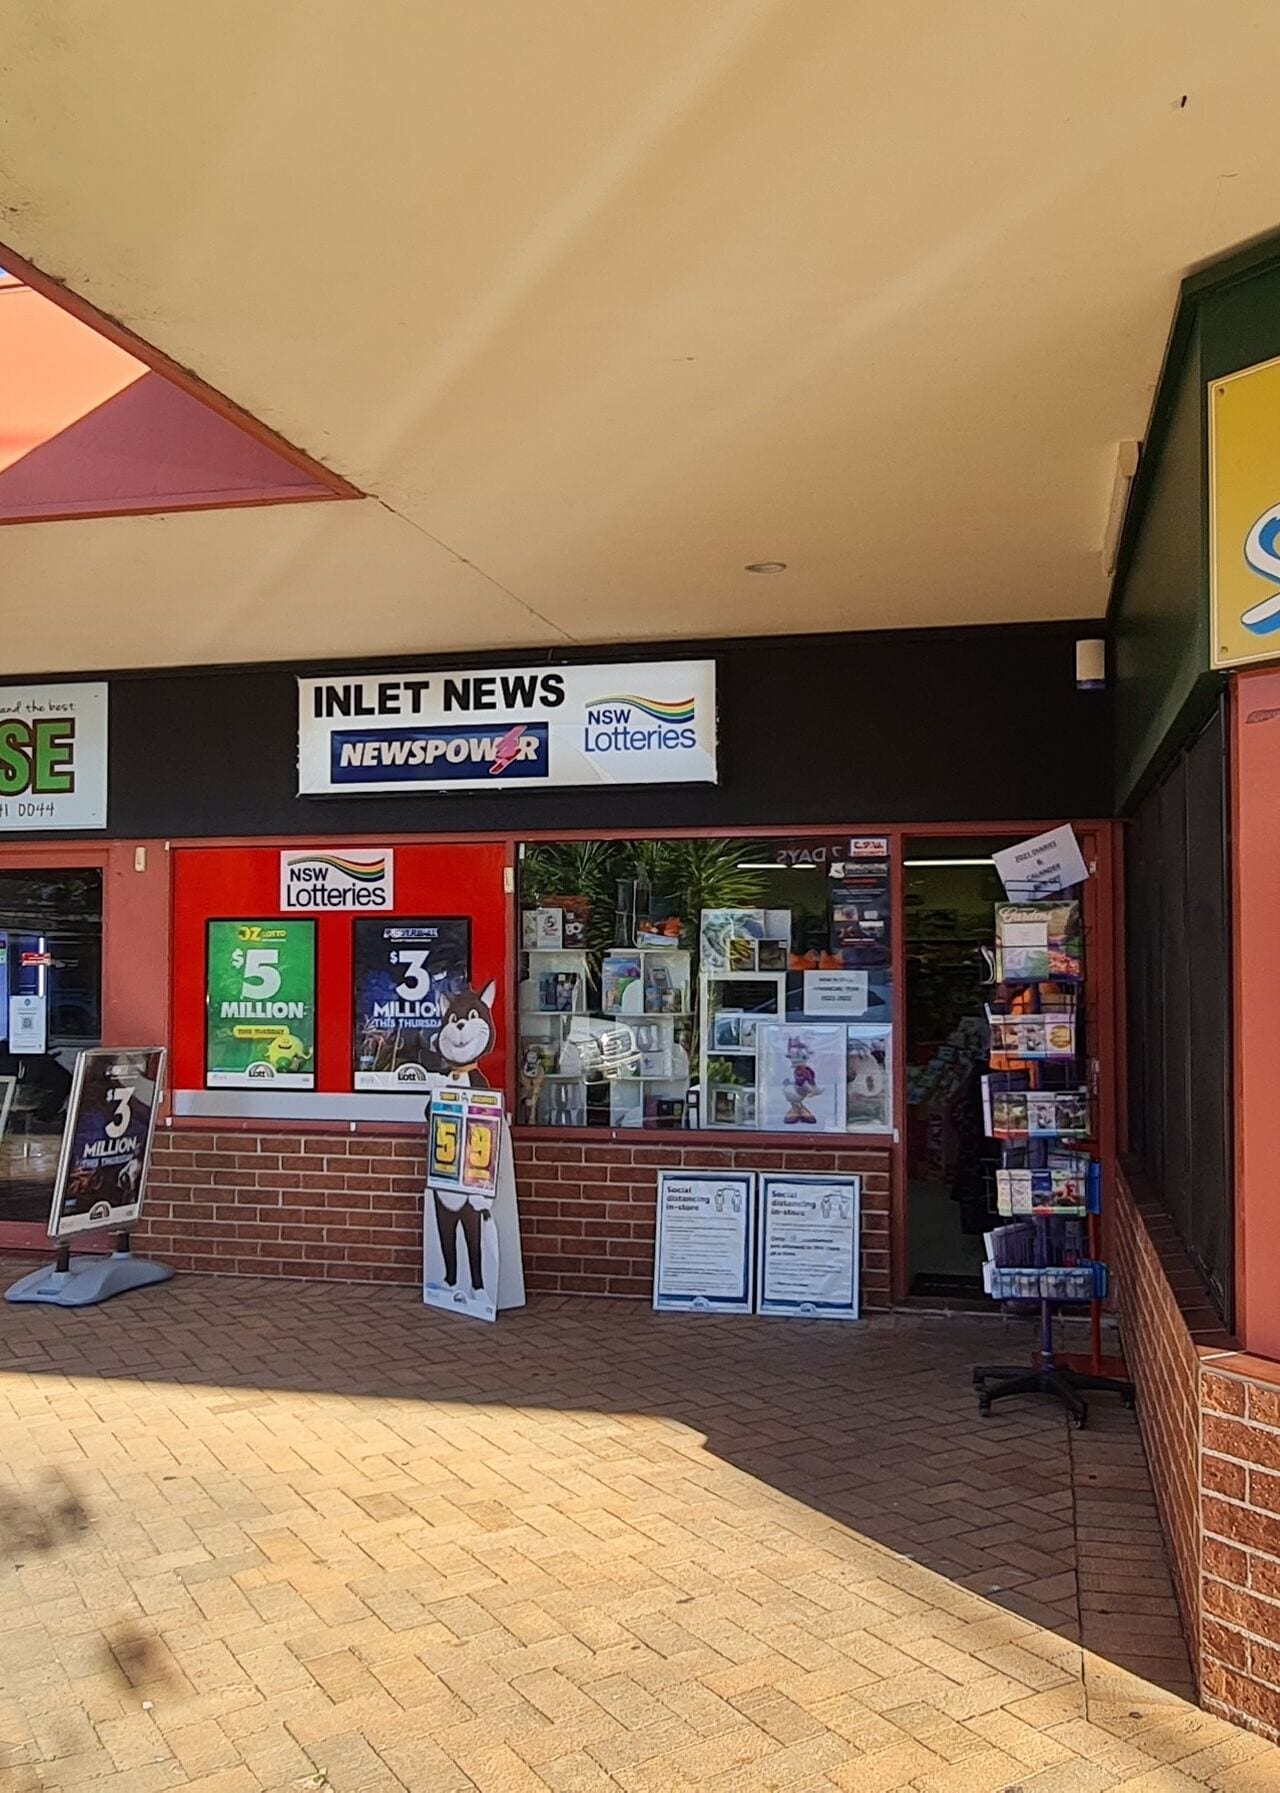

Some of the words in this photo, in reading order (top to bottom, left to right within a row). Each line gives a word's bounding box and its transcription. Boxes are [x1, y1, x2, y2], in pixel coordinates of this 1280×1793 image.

[313, 680, 430, 719] INLET
[442, 672, 566, 713] NEWS
[0, 701, 22, 714] and
[26, 700, 46, 713] the
[49, 699, 77, 713] best
[587, 709, 631, 725] NSW
[583, 722, 696, 754] Lotteries
[17, 802, 55, 818] 0044
[290, 867, 329, 883] NSW
[286, 884, 386, 908] Lotteries
[231, 948, 282, 1000] $5
[389, 949, 431, 1001] $3
[220, 1001, 305, 1019] MILLION
[375, 1018, 395, 1028] THIS
[398, 1018, 442, 1028] THURSDA
[398, 1072, 416, 1081] Lott
[83, 1136, 138, 1158] MILLION
[435, 1120, 457, 1163] 5
[667, 1186, 692, 1194] Social
[772, 1190, 797, 1199] Social
[666, 1195, 710, 1205] distancing
[771, 1199, 816, 1210] distancing
